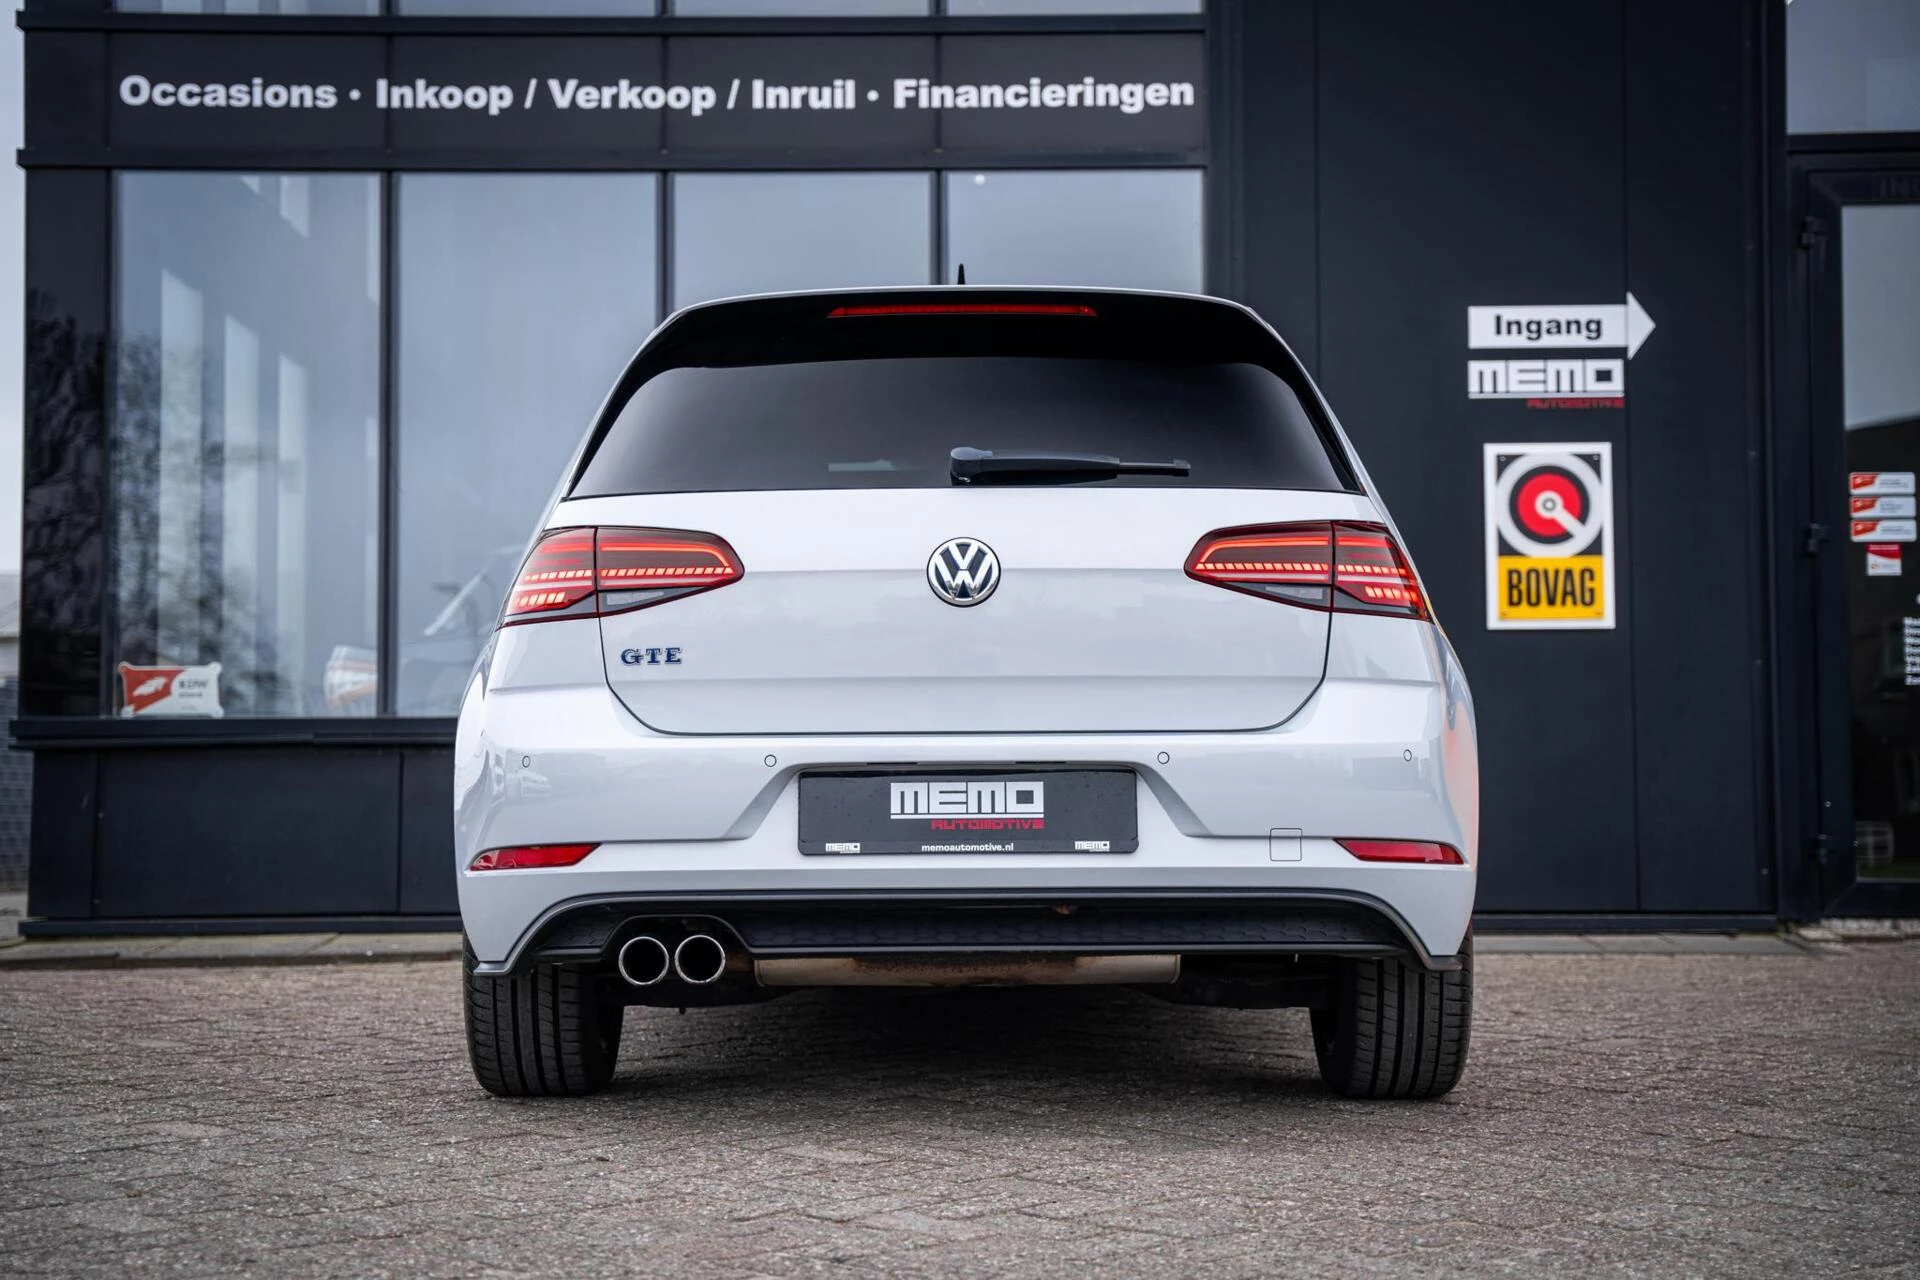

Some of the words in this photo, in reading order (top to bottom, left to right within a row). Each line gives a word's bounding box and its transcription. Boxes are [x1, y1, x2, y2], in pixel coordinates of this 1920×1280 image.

[119, 75, 338, 109] Occasions
[376, 79, 514, 115] Inkoop
[548, 79, 717, 116] Verkoop
[752, 79, 856, 109] Inruil
[893, 77, 1195, 114] Financieringen
[1495, 315, 1602, 341] Ingang
[1468, 360, 1624, 393] MEMO
[1507, 567, 1595, 607] BOVAG
[620, 647, 682, 665] GTE
[890, 781, 1044, 814] MEMO
[931, 818, 1045, 830] AUTOMOTIVE
[825, 843, 860, 852] MEMO
[921, 842, 1014, 852] memoautomotive.nl
[1074, 841, 1110, 850] MEMO
